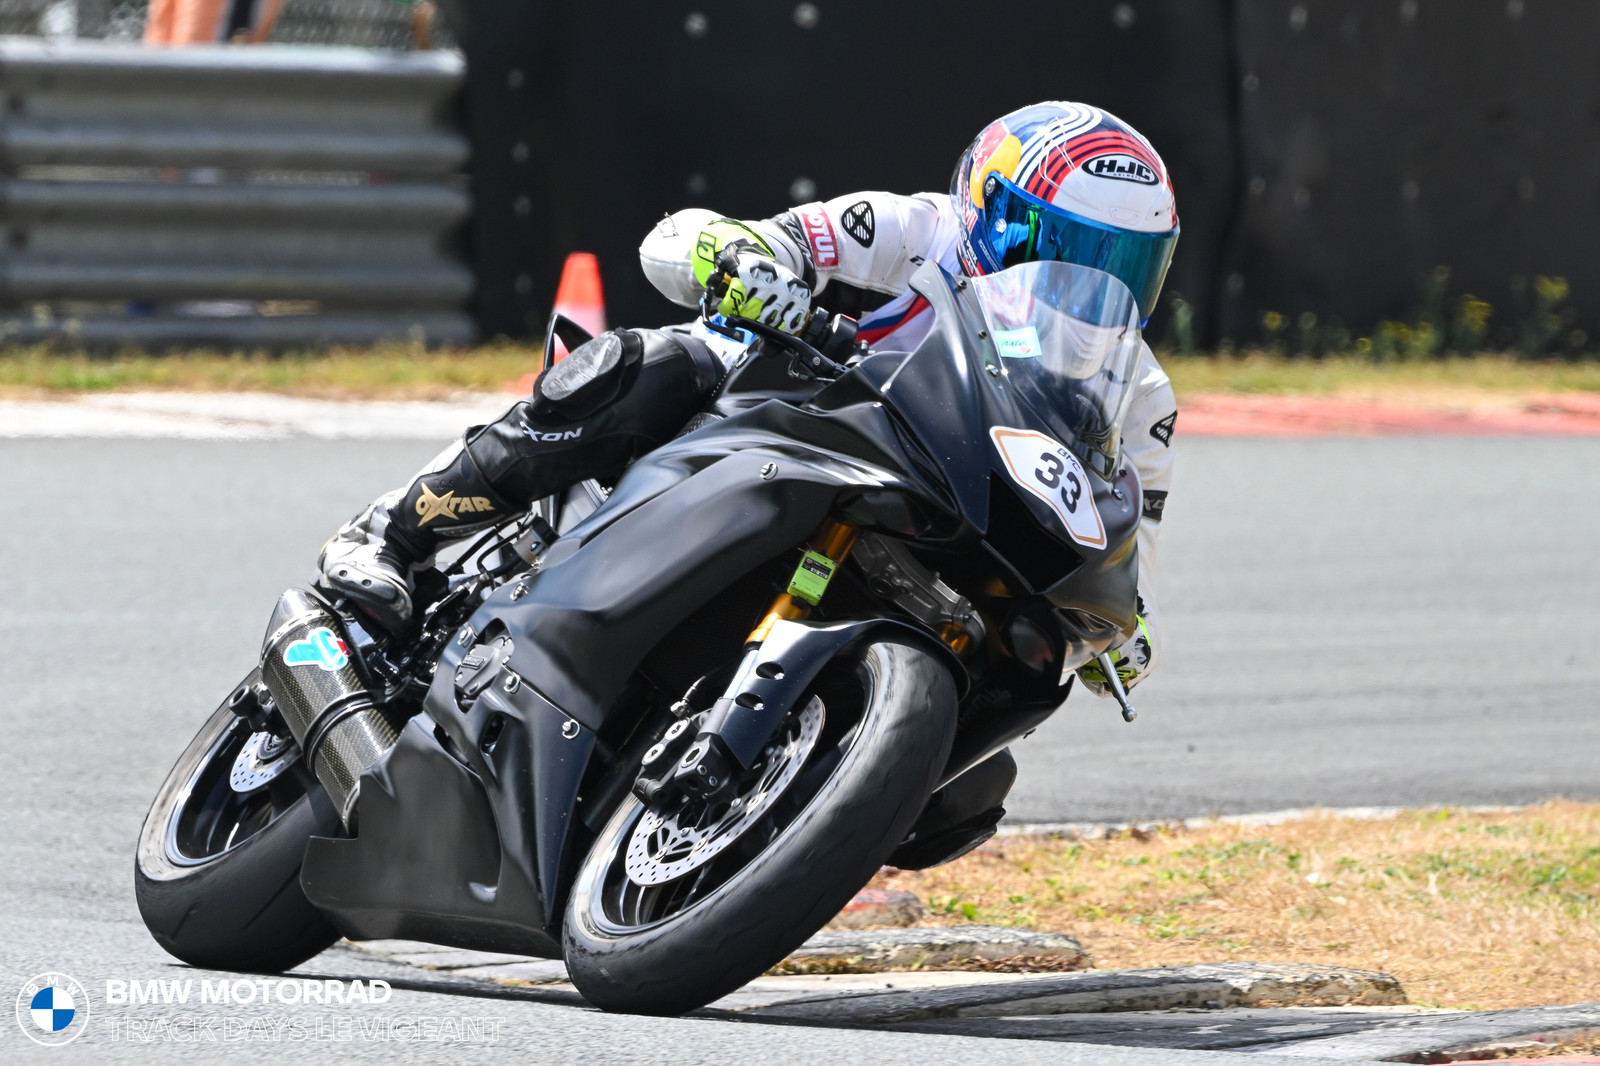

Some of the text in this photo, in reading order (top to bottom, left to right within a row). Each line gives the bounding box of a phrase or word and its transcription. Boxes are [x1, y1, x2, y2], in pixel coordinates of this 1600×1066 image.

[1095, 159, 1152, 181] HJC
[805, 209, 836, 264] OTUL
[519, 420, 584, 443] XON
[415, 481, 496, 528] OXTAR
[1034, 451, 1082, 515] 33
